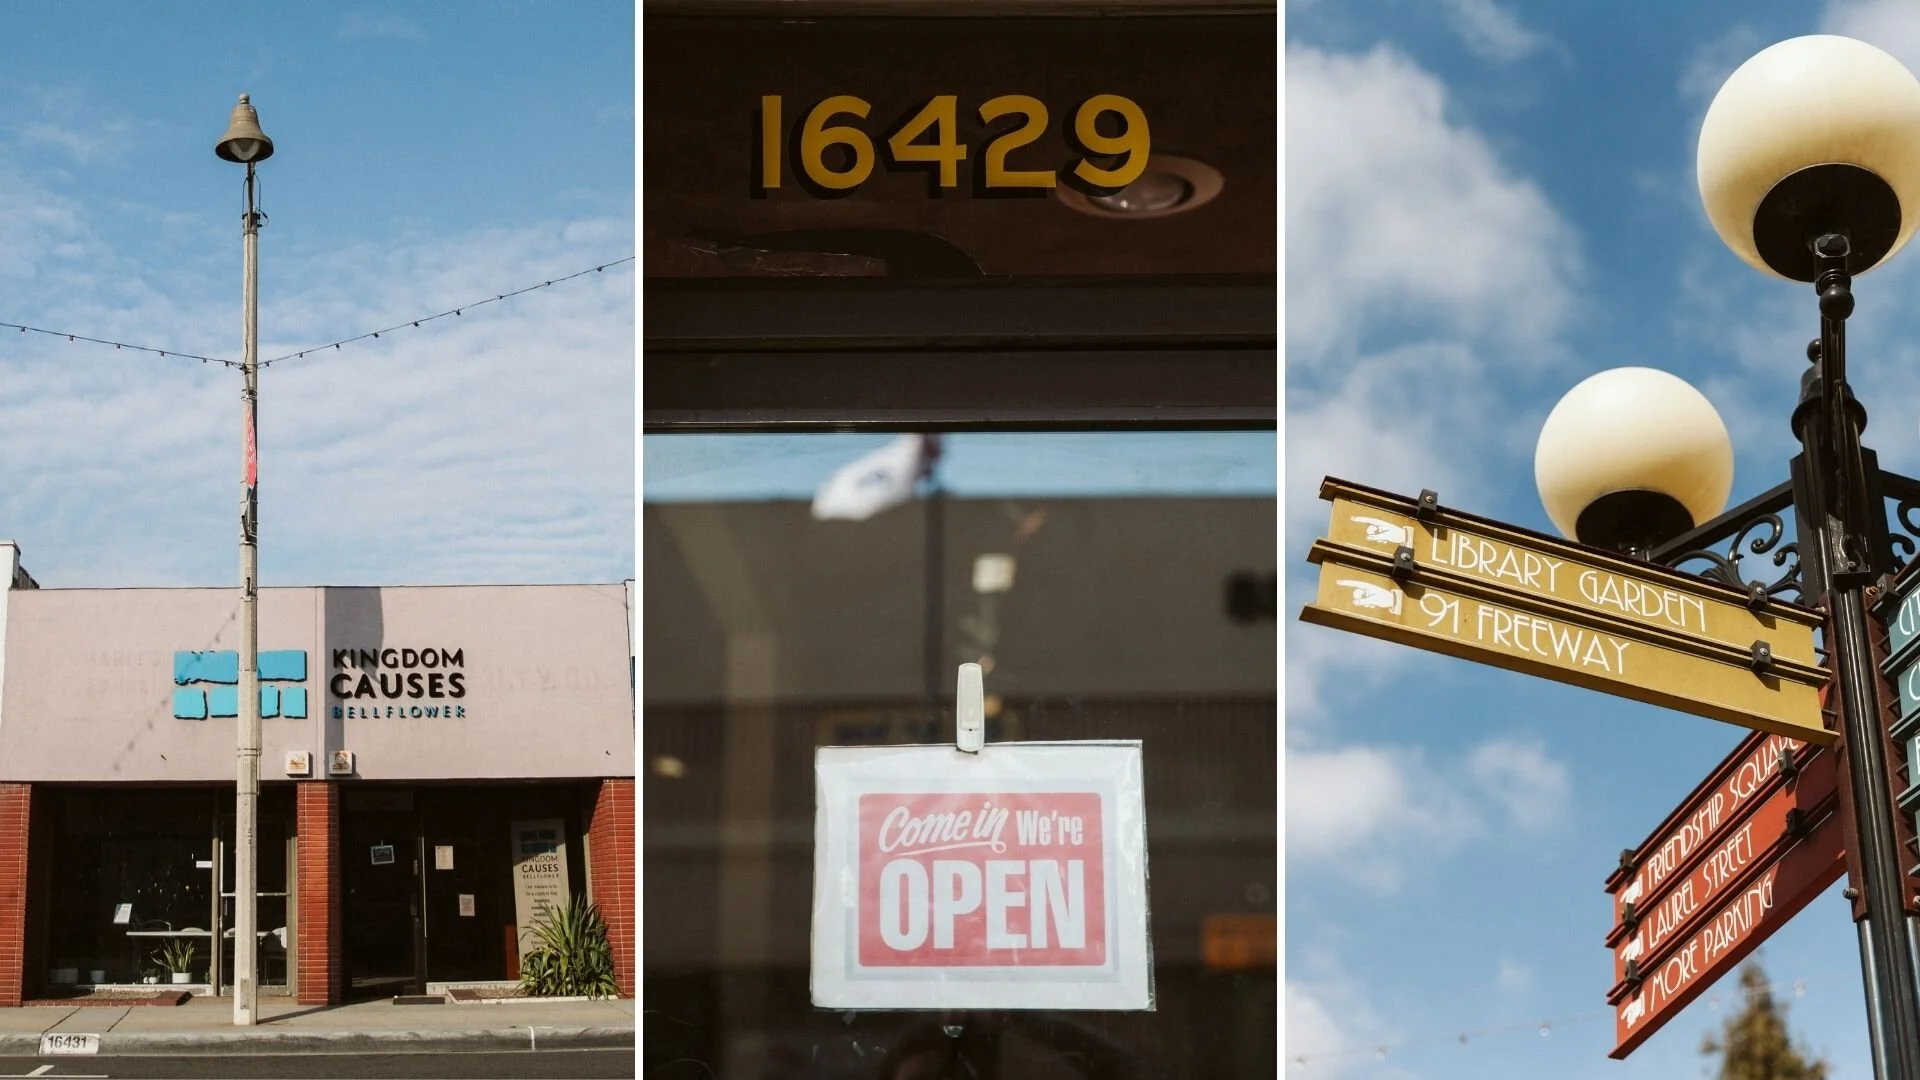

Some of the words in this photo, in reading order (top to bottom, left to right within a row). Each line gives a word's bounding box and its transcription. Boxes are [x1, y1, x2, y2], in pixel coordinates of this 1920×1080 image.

[761, 94, 1151, 190] 16429
[1431, 527, 1564, 593] LIBRARY
[1578, 570, 1707, 632] GARDEN
[332, 647, 465, 669] KINGDOM
[1419, 592, 1460, 634] 91
[1476, 604, 1631, 675] FREEWAY
[330, 672, 466, 699] CAUSES
[331, 705, 466, 719] BELLFLOWER
[521, 864, 559, 873] CAUSES
[878, 806, 973, 853] Come
[971, 801, 1010, 854] in
[1015, 810, 1084, 846] We're
[1647, 792, 1724, 890] FRIENDSHIP
[879, 858, 1086, 951] OPEN
[1648, 880, 1699, 950] LAUREL
[1703, 822, 1753, 898] STREET
[1650, 939, 1698, 1012] MORE
[1702, 873, 1774, 964] PARKING
[48, 1036, 87, 1048] 16431
